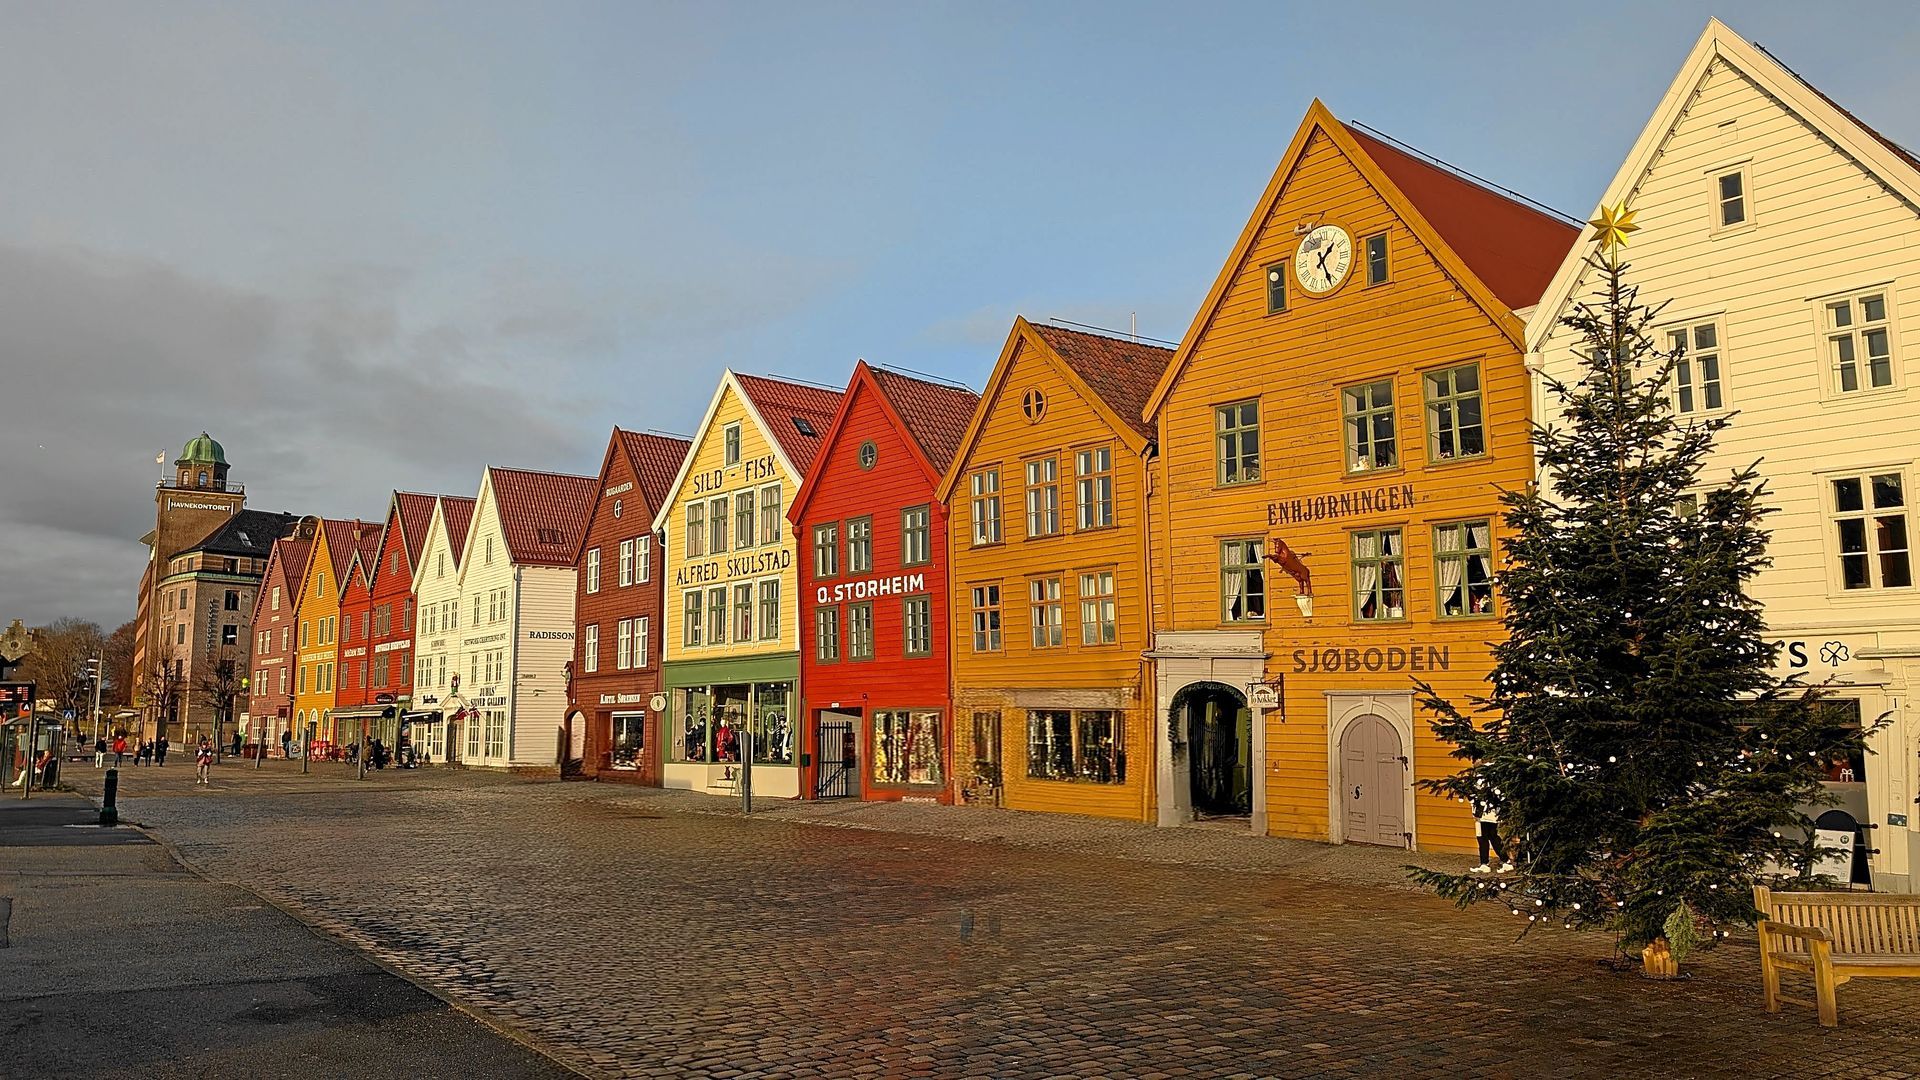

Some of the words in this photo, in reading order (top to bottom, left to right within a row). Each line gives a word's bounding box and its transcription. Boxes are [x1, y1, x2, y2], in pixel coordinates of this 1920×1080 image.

[693, 469, 723, 494] SILD
[745, 454, 776, 482] FISK
[170, 501, 231, 511] HAVNEKONTORET
[1267, 484, 1415, 526] ENHJØRNINGEN
[676, 562, 719, 585] ALFRED
[727, 549, 791, 578] SKULSTAD
[816, 585, 832, 604] O.
[834, 573, 925, 601] STORHEIM
[529, 631, 575, 640] RADISSON
[1292, 645, 1450, 674] SJØBODEN
